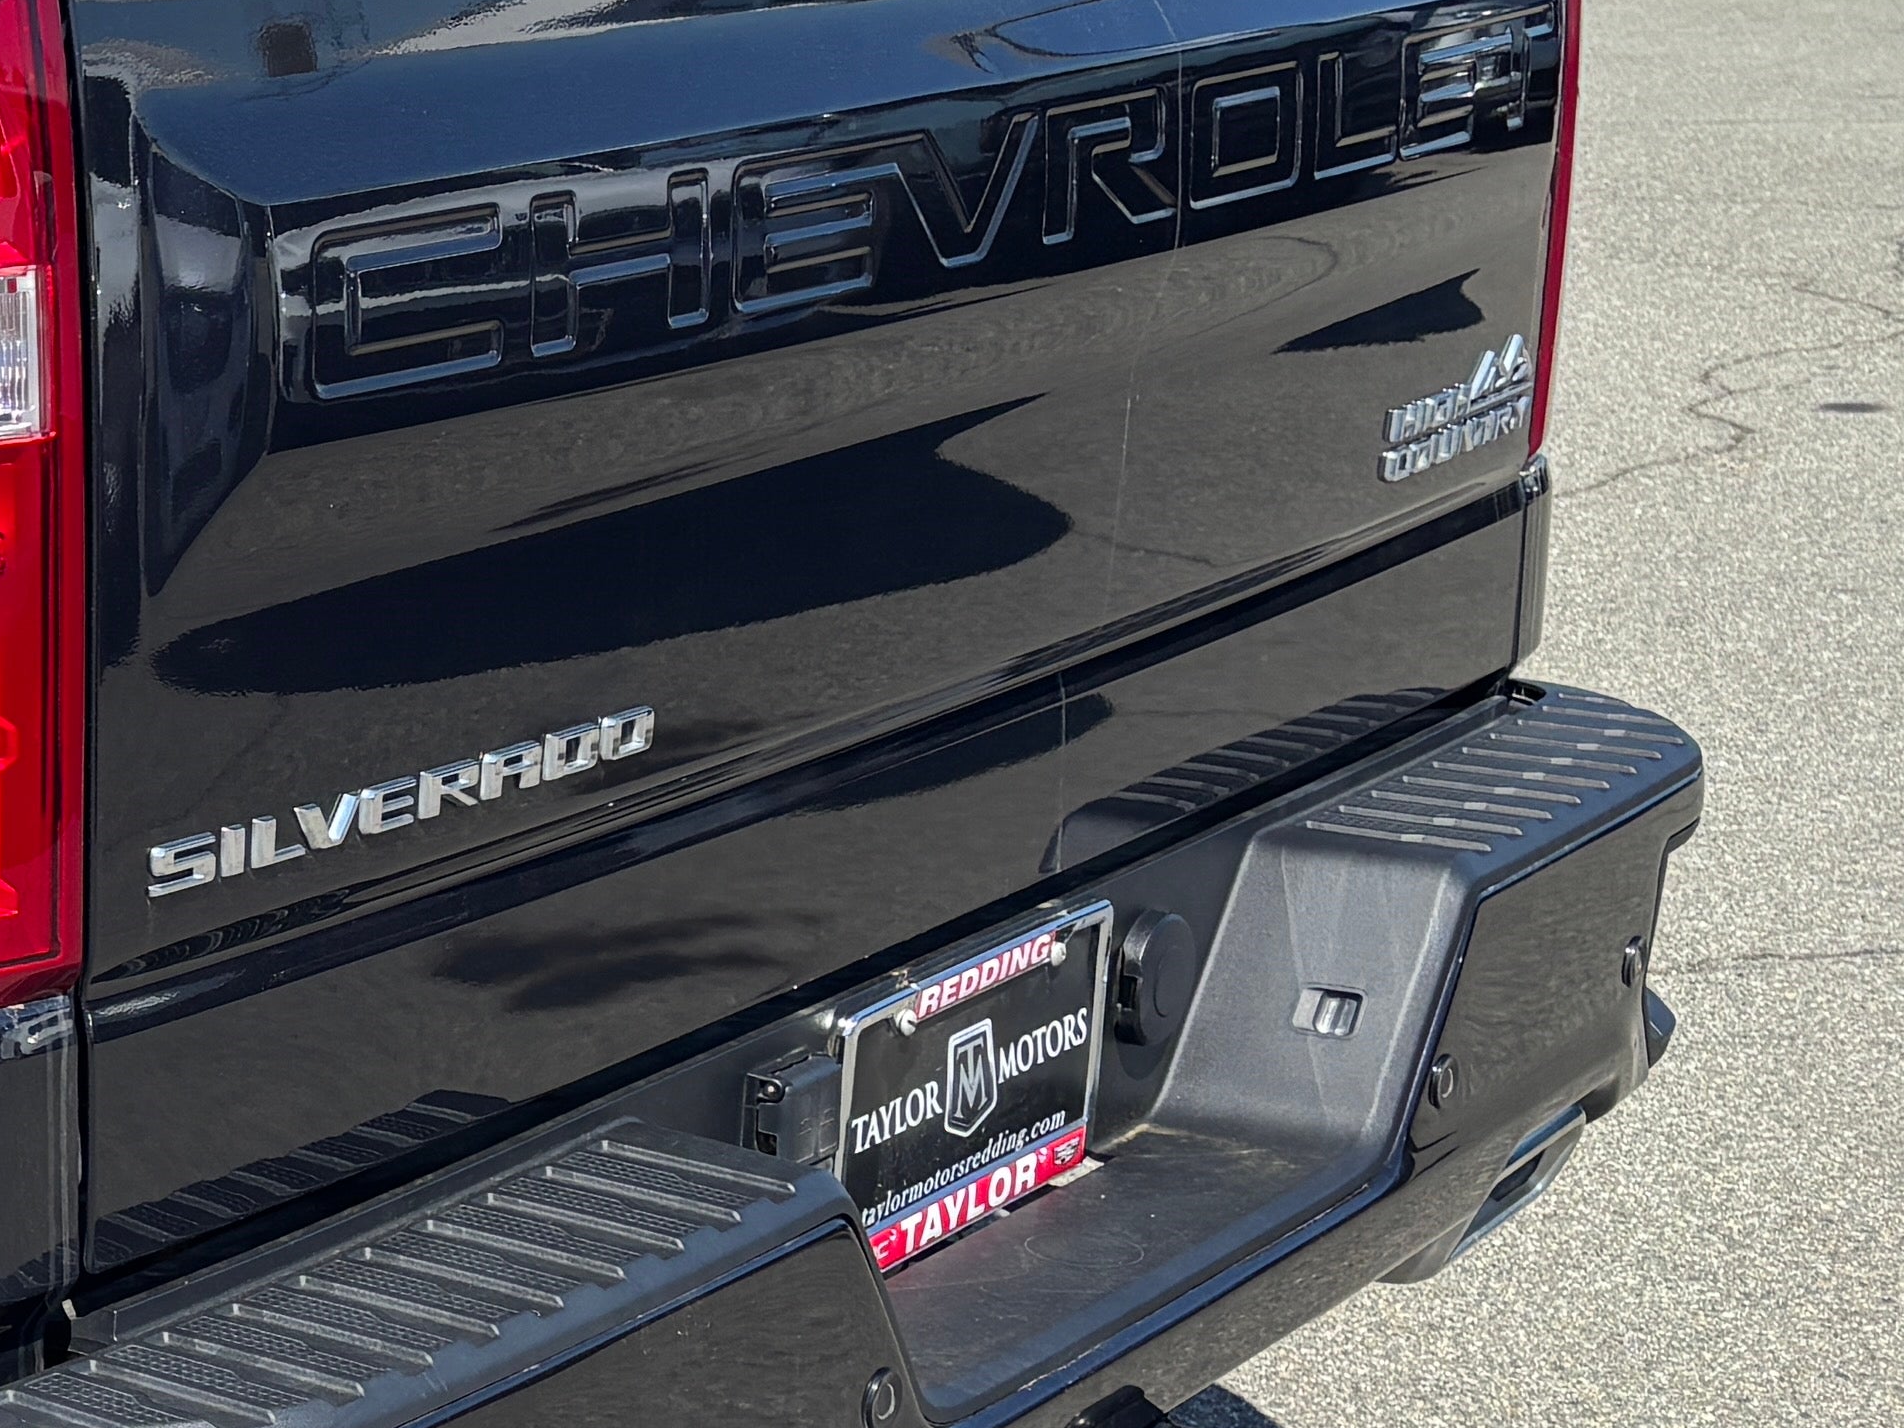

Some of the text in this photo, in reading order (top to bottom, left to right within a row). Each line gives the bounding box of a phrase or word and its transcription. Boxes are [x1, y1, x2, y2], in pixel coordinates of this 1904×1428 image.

[311, 2, 1555, 401] CHEVROLET
[1377, 395, 1532, 482] COUNTRY
[1382, 383, 1473, 443] HIGH
[147, 705, 656, 897] SILVERADO
[918, 933, 1053, 1019] REDDING
[851, 1007, 1088, 1154] TAYLOR MOTORS
[861, 1109, 1066, 1227] taylormotorsredding.com
[900, 1152, 1038, 1255] TAYLOR
